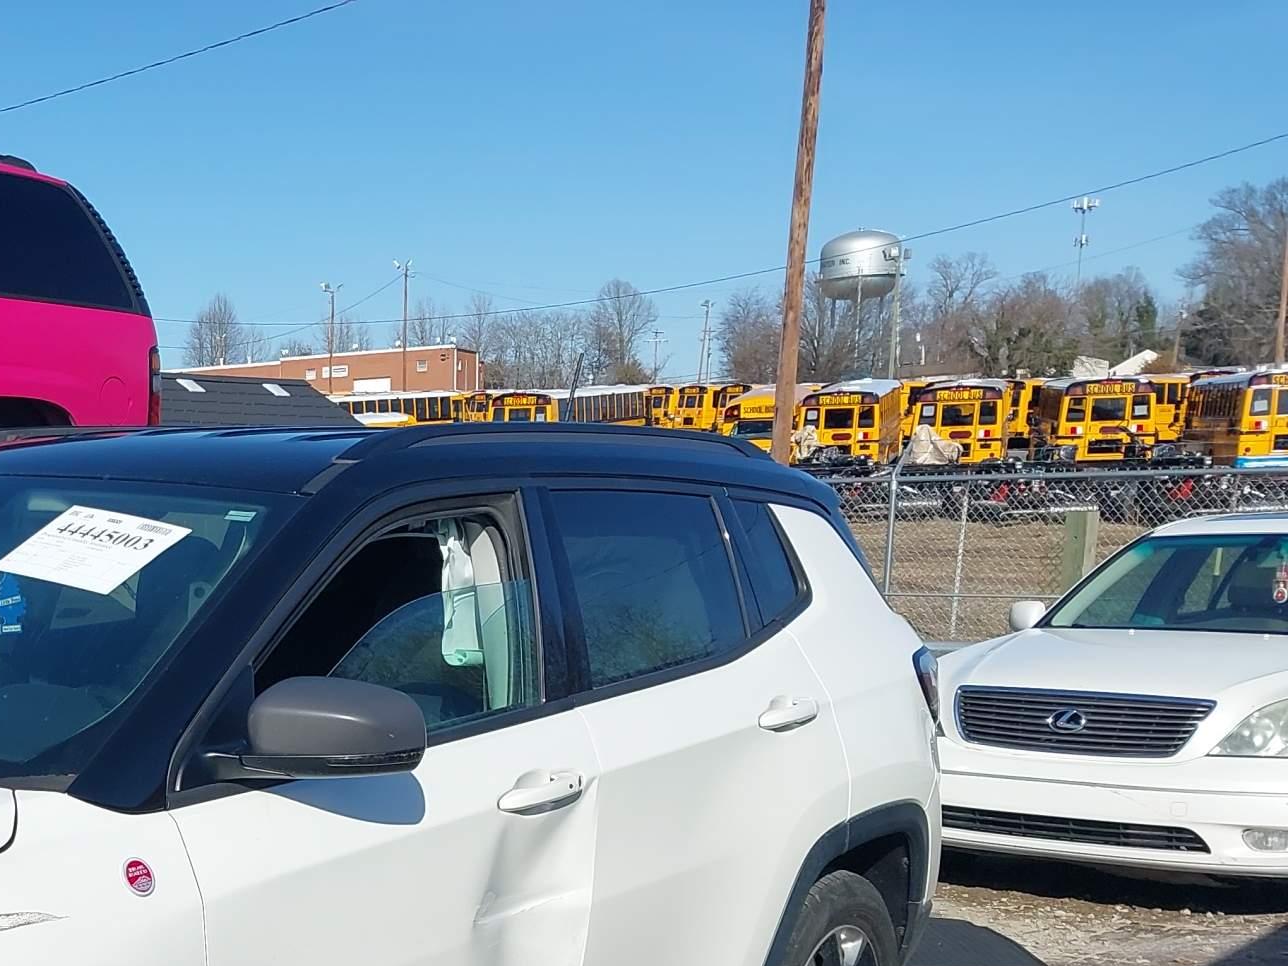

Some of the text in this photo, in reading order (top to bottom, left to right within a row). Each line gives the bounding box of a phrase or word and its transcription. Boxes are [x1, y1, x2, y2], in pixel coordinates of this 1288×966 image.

[1088, 383, 1134, 394] SCHOOL BUS
[938, 390, 968, 401] SCHOOL
[56, 521, 155, 551] 44445003
